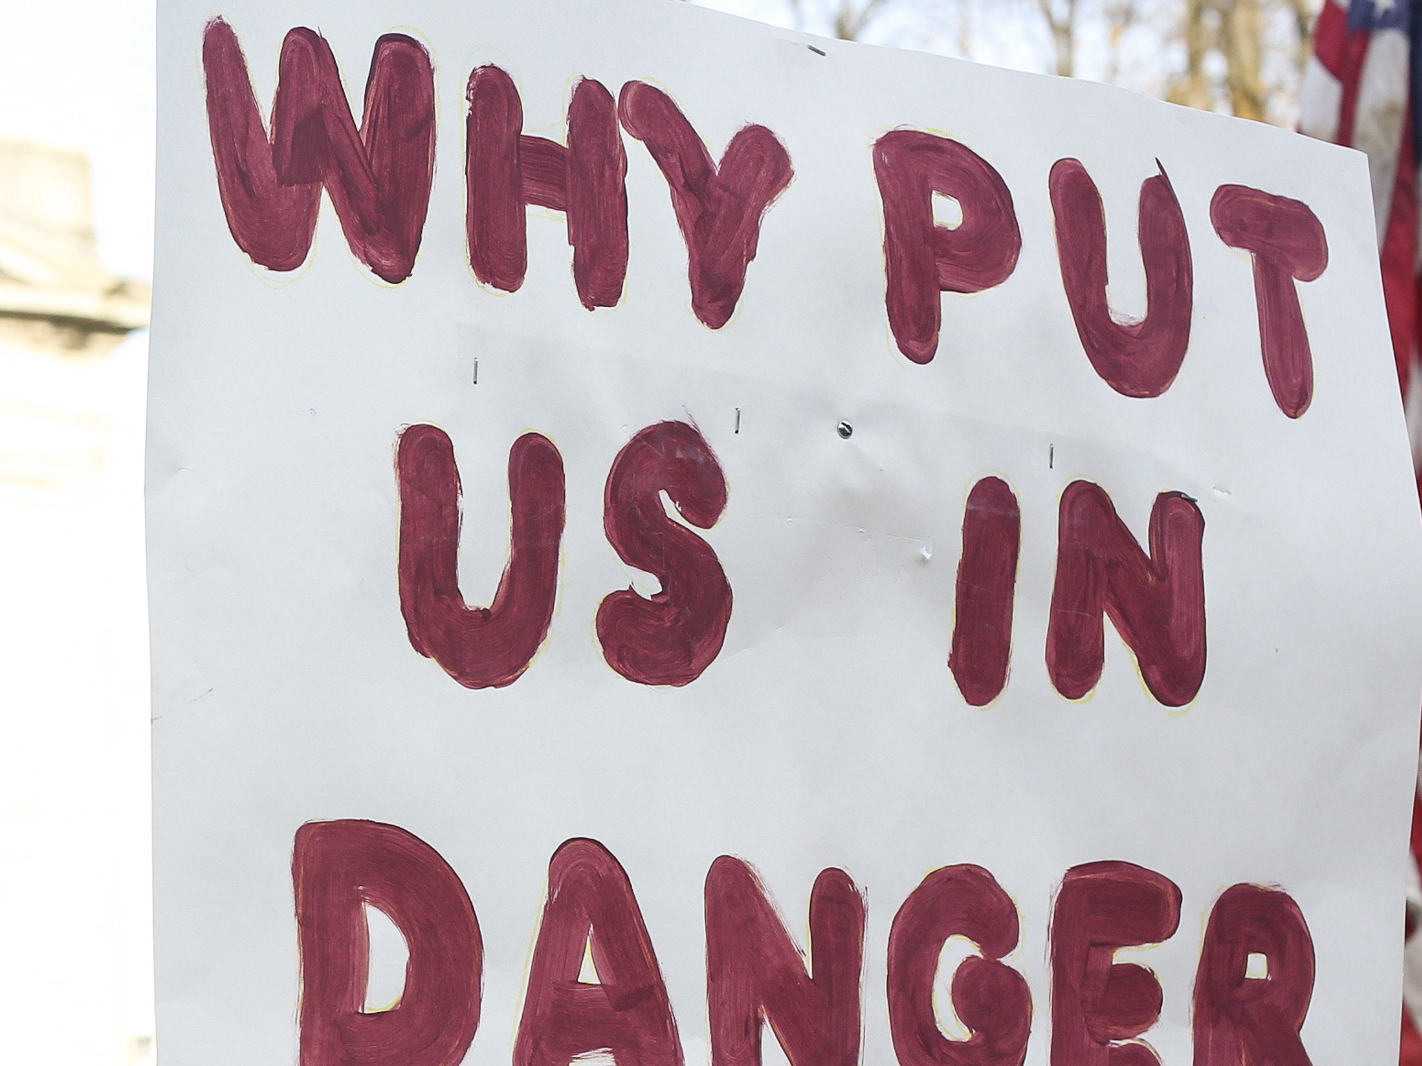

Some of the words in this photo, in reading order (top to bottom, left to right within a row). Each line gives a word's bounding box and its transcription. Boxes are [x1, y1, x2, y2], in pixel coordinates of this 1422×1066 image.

[203, 16, 792, 330] WHY
[874, 129, 1327, 420] PUT
[396, 420, 734, 690] US
[947, 475, 1207, 708] IN
